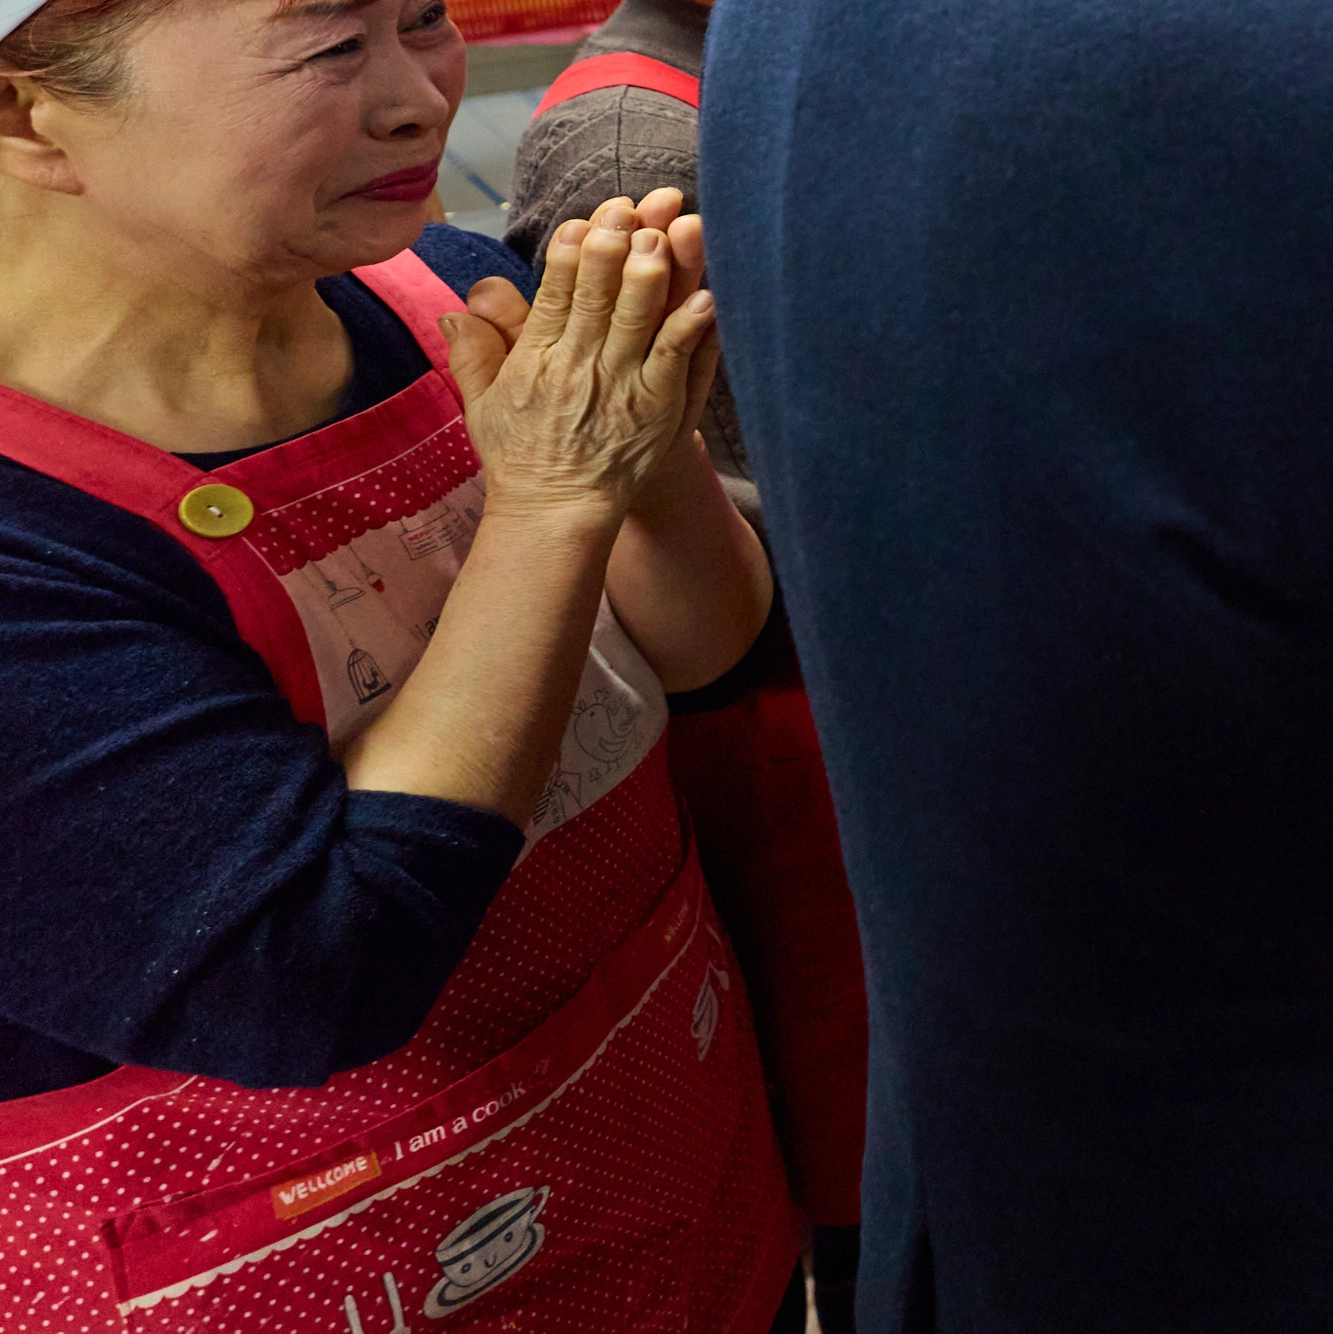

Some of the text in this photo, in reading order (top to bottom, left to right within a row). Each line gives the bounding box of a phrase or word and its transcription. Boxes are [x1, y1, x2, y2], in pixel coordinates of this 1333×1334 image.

[394, 1081, 526, 1161] I am a cook
[278, 1154, 369, 1205] WELLCOME
